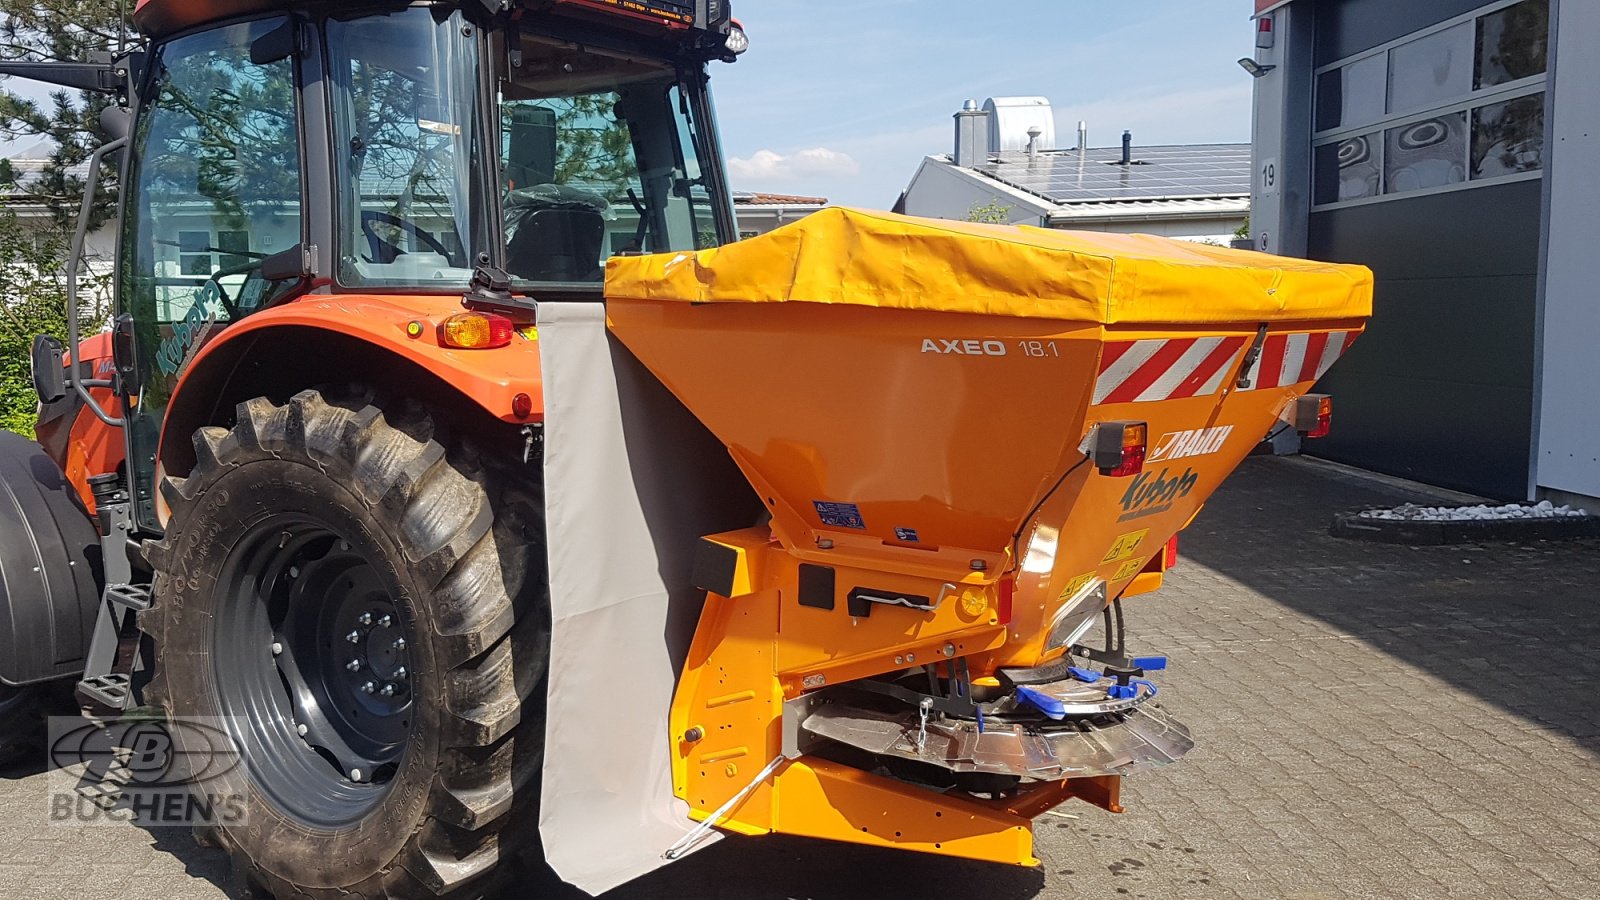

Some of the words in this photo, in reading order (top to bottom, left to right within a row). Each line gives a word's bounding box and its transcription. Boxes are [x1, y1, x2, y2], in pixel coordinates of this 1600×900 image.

[1263, 164, 1275, 187] 19
[156, 279, 221, 378] Kubota
[921, 339, 1007, 356] AXEO
[1018, 340, 1059, 357] 18.1
[1119, 467, 1198, 511] Kubota
